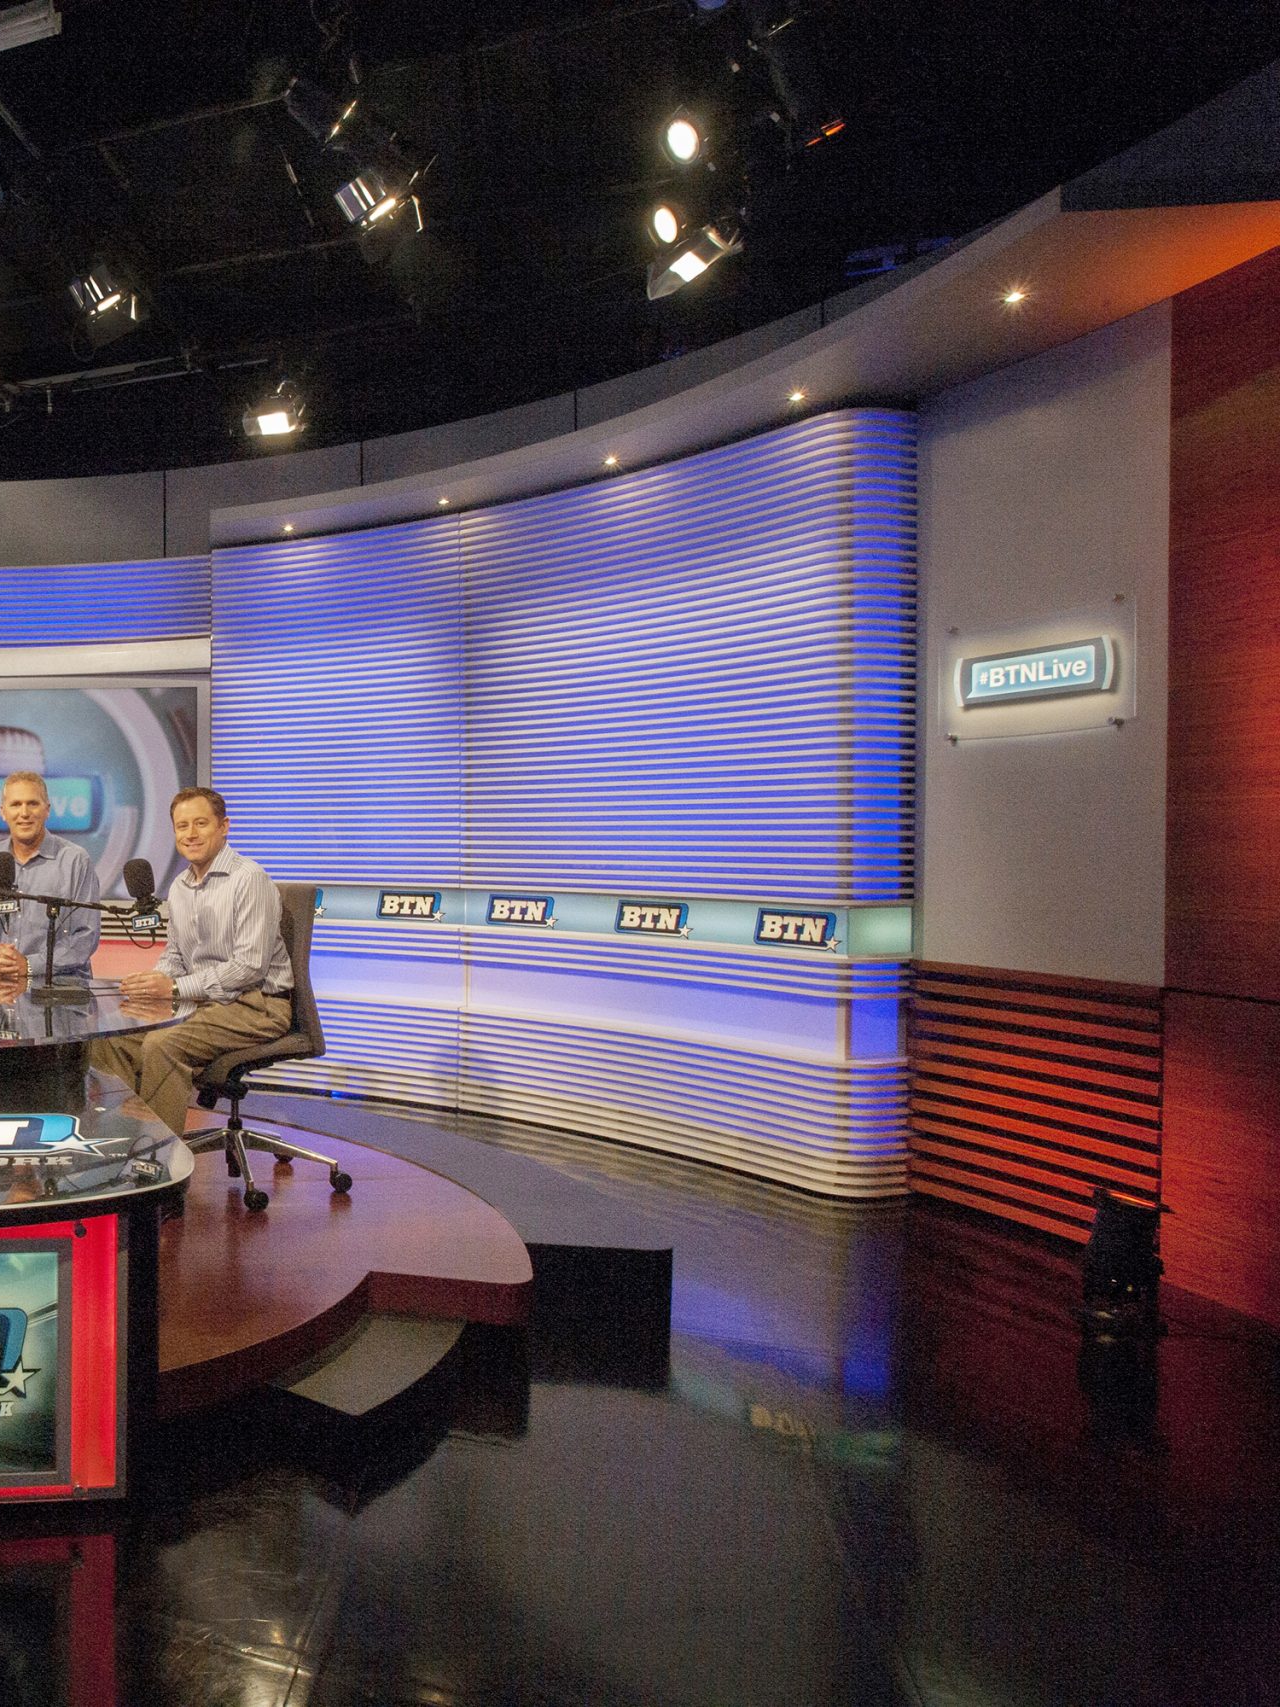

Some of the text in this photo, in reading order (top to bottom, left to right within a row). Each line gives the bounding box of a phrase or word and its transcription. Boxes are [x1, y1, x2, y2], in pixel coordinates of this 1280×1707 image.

[979, 659, 1088, 688] #BTNLive
[381, 895, 434, 916] BTN
[491, 899, 546, 922] BTN
[620, 905, 680, 930] BTN
[760, 914, 827, 942] BTN
